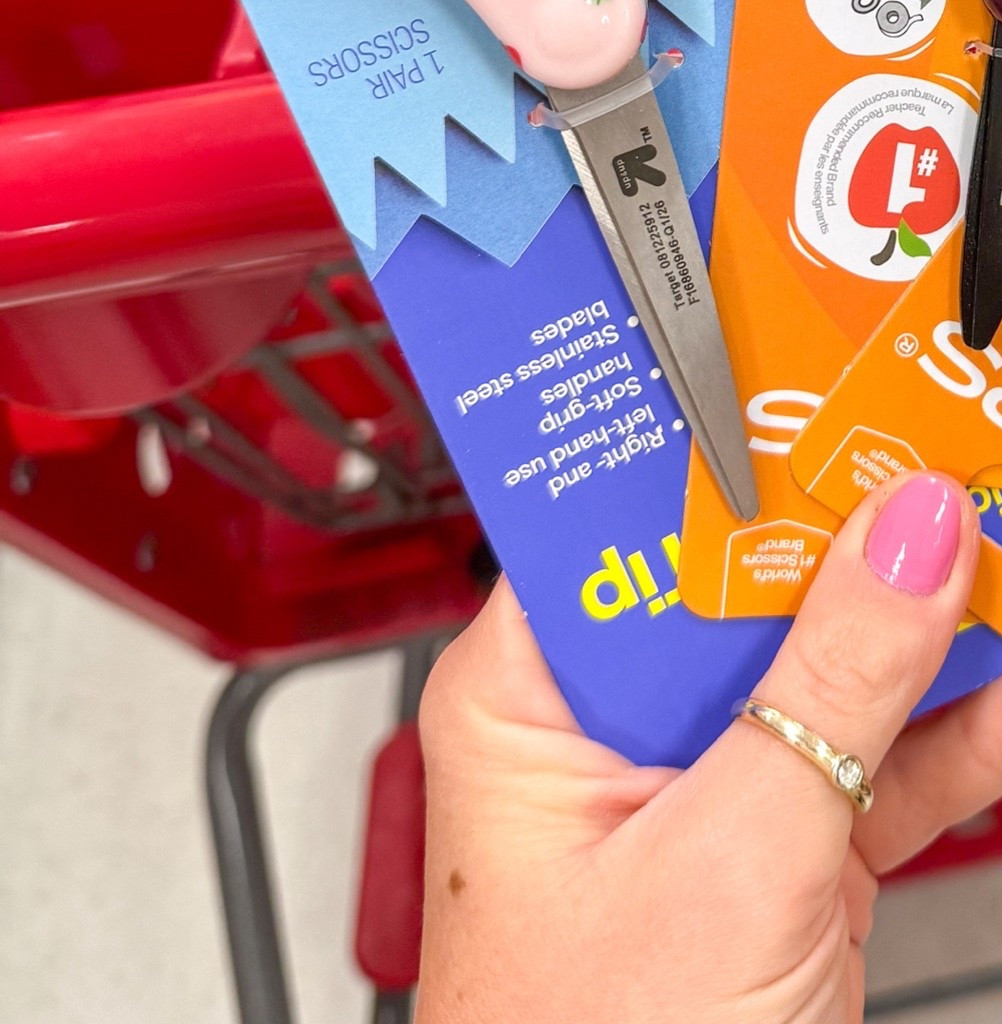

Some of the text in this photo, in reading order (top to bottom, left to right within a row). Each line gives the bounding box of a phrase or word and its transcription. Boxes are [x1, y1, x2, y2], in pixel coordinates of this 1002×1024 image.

[308, 18, 430, 87] SCISSORS
[365, 49, 445, 99] 1 PAIR
[616, 158, 632, 190] up&up
[812, 88, 955, 235] La marque recommandée par les enseignants
[825, 103, 926, 207] Teacher Recommended Brand
[887, 141, 939, 214] #1
[639, 202, 686, 311] Target 081225912
[654, 199, 700, 306] F16860946-Q1/26
[530, 299, 610, 346] blades
[454, 324, 619, 417] Stainless steel
[538, 376, 642, 435] Soft-grip
[540, 352, 633, 406] handles
[503, 404, 656, 488] left-hand use
[547, 424, 666, 501] Right- and
[741, 554, 798, 567] Scissors
[753, 568, 802, 583] World's
